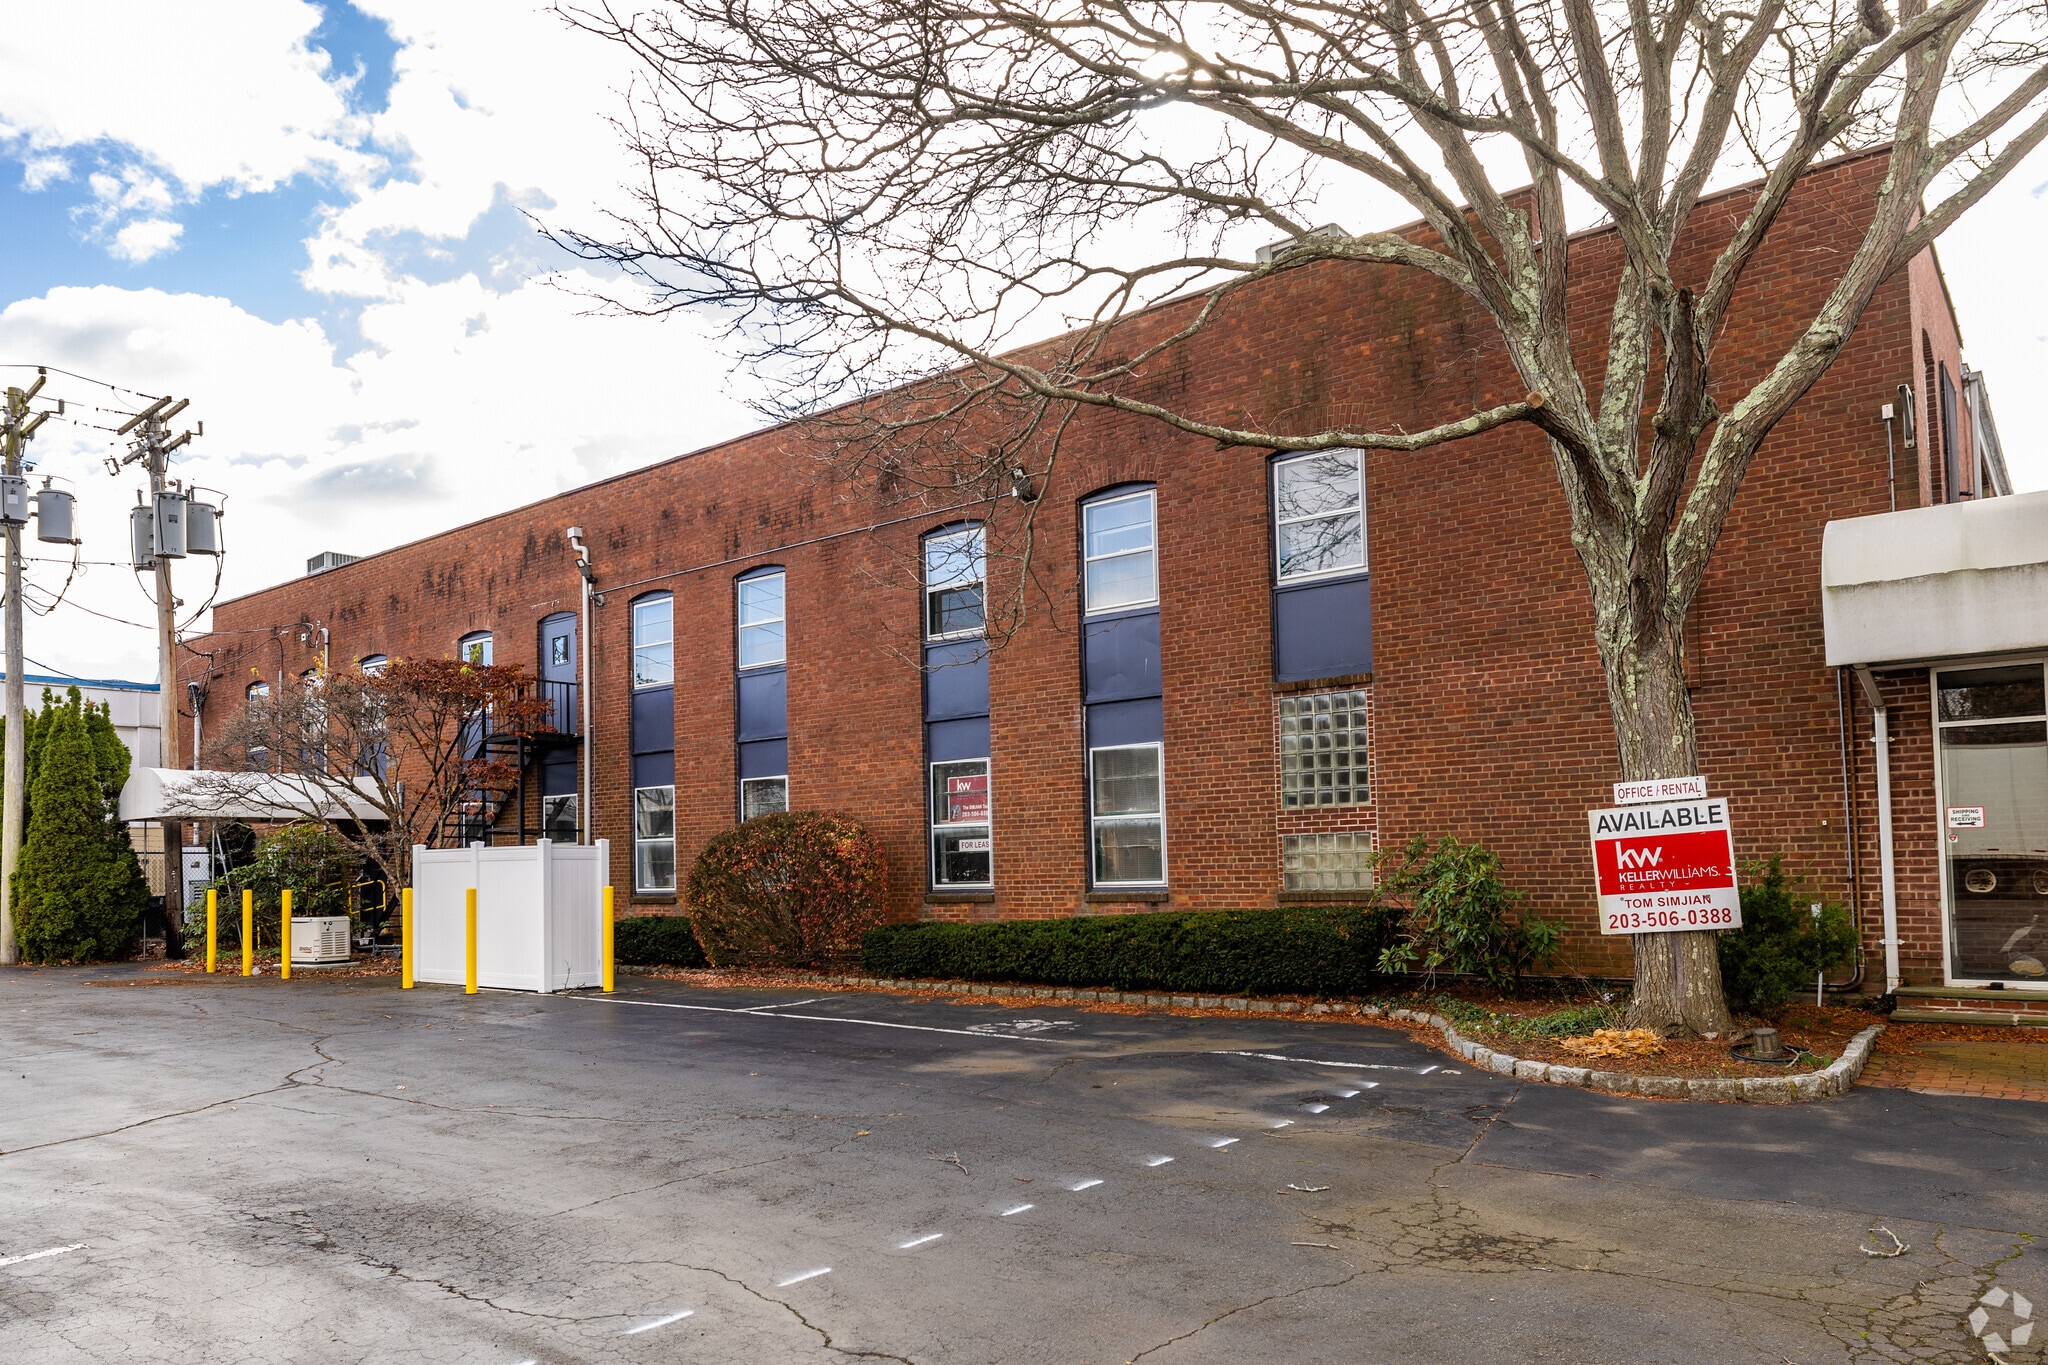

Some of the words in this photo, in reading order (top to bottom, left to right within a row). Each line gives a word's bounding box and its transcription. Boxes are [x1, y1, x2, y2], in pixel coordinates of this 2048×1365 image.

[956, 779, 971, 792] kw
[1617, 785, 1653, 800] OFFICE
[1662, 782, 1702, 796] RENTAL
[1597, 804, 1723, 834] AVAILABLE
[1615, 841, 1662, 870] kw
[1620, 881, 1676, 891] REALTY
[1625, 898, 1653, 909] TOM
[1657, 895, 1711, 907] SIMJIAN
[1609, 907, 1732, 930] 203-506-0388
